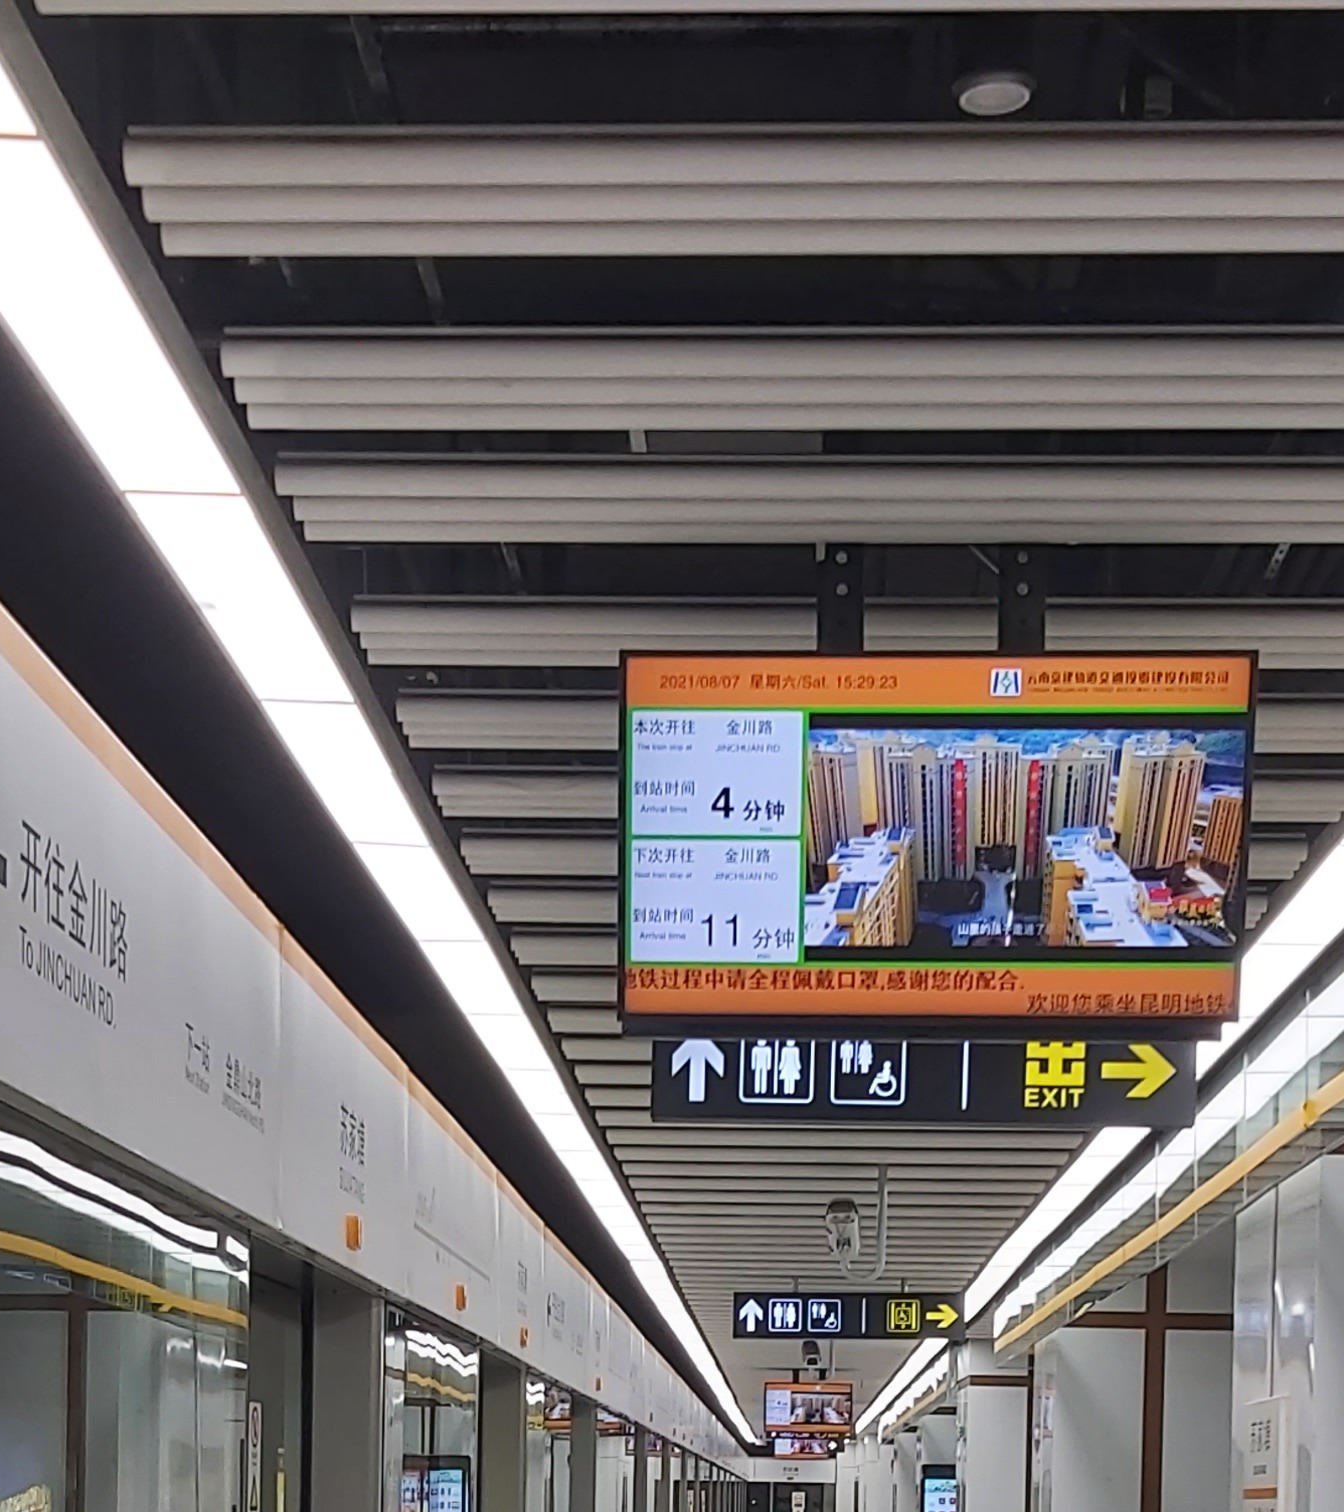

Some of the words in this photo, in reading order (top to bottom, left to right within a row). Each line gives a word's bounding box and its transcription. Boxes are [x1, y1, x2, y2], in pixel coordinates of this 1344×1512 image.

[659, 674, 740, 690] 2021/08/07
[633, 719, 696, 736] 本次开往
[726, 719, 773, 736] 金川路
[634, 780, 695, 797] 到站时间
[711, 787, 734, 819] 4
[742, 800, 785, 822] 分钟
[635, 847, 694, 864] 下次开往
[725, 847, 770, 864] 金川路
[20, 819, 129, 984] 开往金川路
[633, 908, 694, 924] 到站时间
[701, 913, 738, 947] 11
[752, 928, 795, 949] 分钟
[19, 926, 34, 969] To
[35, 941, 97, 1012] JINCHUAN
[97, 988, 117, 1030] RD.
[185, 1022, 210, 1073] 下一站
[1023, 1087, 1085, 1108] EXIT
